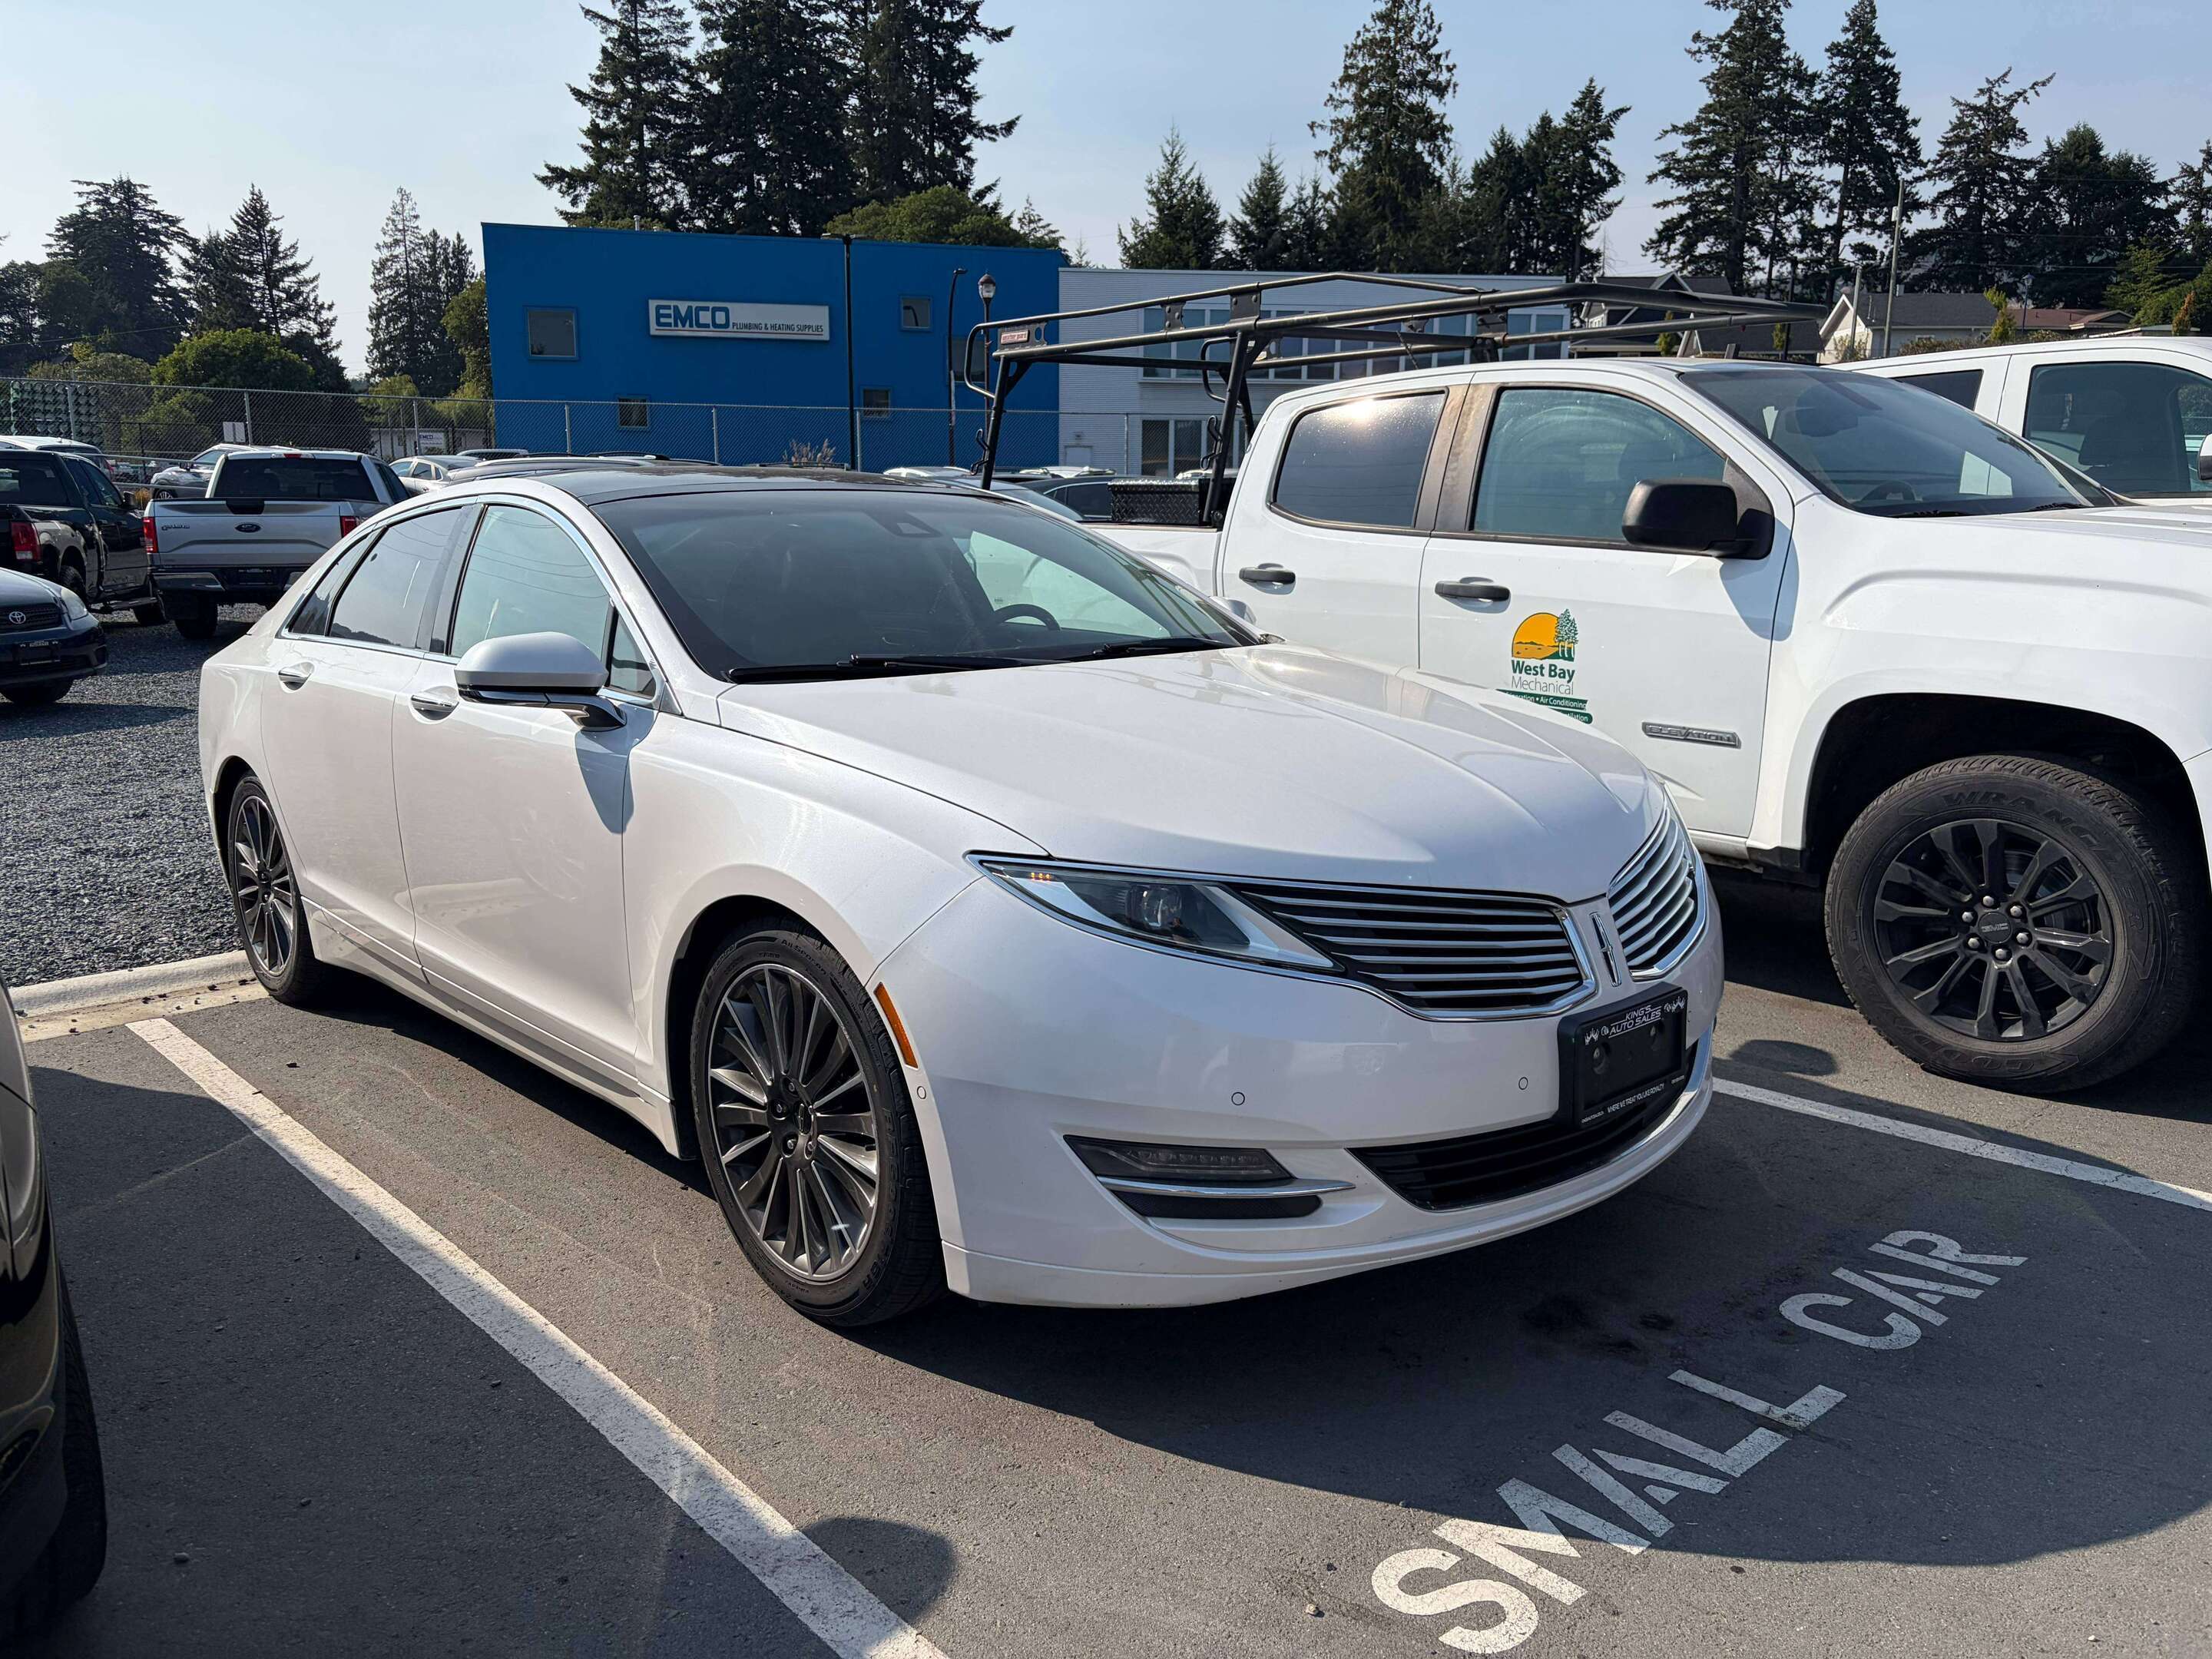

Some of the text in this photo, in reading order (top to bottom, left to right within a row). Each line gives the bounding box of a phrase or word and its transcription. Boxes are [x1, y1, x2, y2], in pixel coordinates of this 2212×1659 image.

[655, 305, 823, 333] EMCO PLUMBING & HEATING SUPPLIES
[1511, 660, 1575, 684] West Bay
[1511, 675, 1574, 695] Mechanical
[1549, 697, 1587, 711] Conditioning
[1647, 725, 1735, 743] ELEVATION
[1610, 1009, 1661, 1035] AUTO SALES
[1625, 1005, 1651, 1021] KING'S
[1371, 1230, 2028, 1655] SMALL CAR
